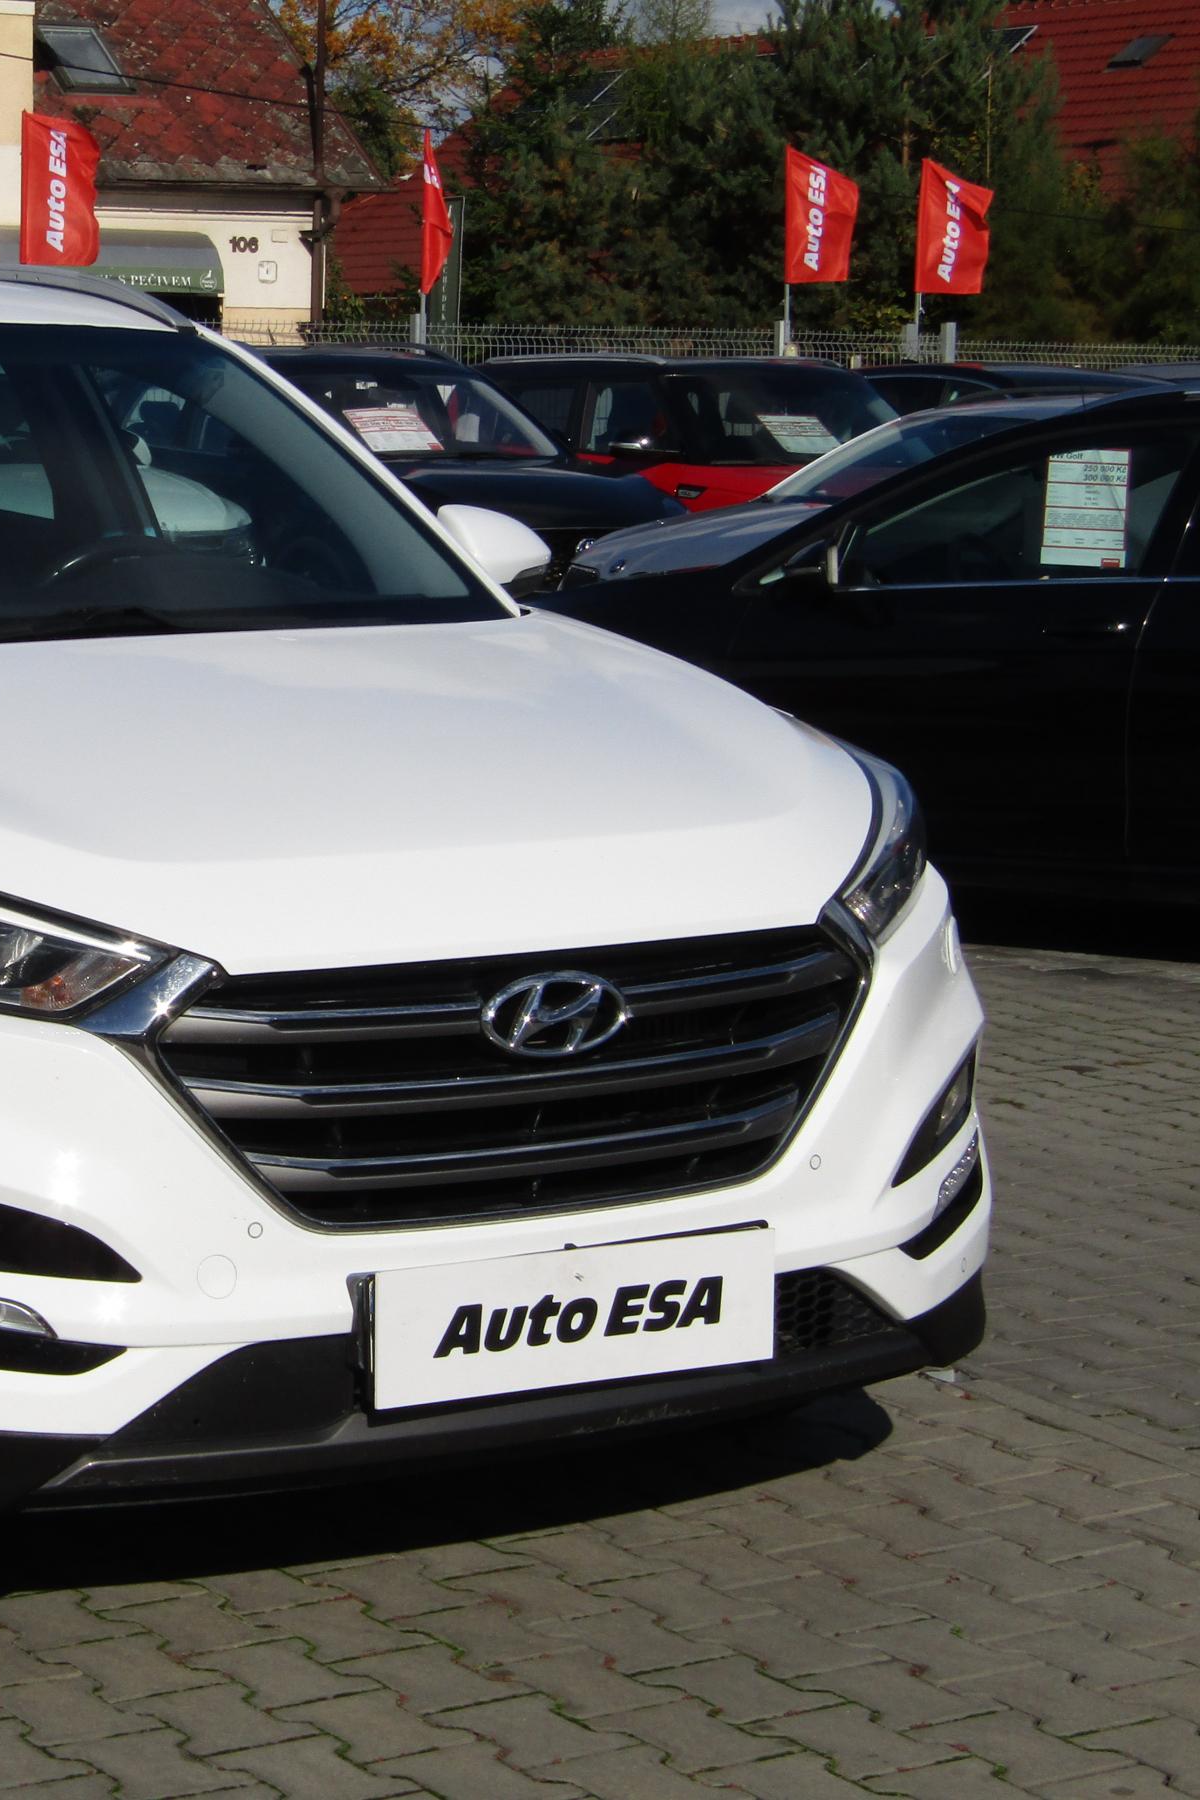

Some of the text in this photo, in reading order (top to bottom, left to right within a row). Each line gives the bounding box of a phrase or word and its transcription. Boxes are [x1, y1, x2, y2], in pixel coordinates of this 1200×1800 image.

[46, 129, 68, 253] Auto ESA
[803, 207, 824, 272] Auto
[937, 221, 961, 284] Auto
[130, 273, 192, 287] PEČIVEM
[1066, 452, 1084, 460] Golf
[433, 1275, 723, 1358] Auto ESA
